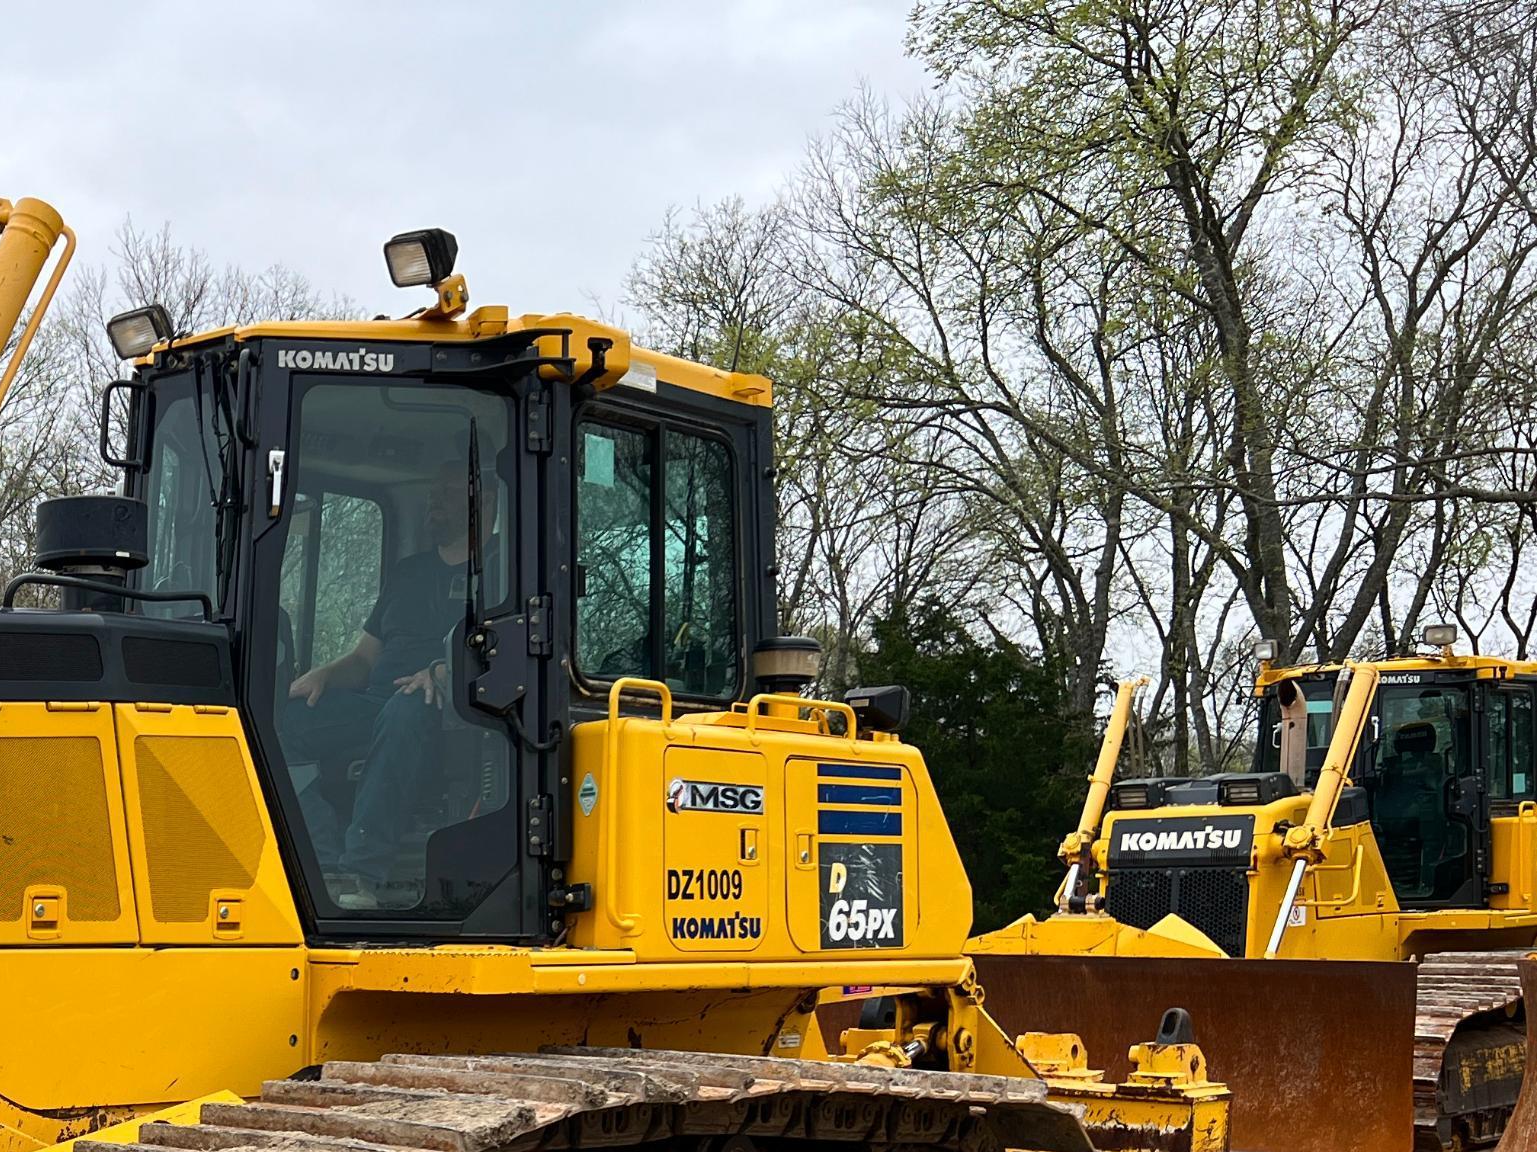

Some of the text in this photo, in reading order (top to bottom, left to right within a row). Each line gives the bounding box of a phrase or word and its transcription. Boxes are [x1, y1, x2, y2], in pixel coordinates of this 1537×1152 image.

[278, 348, 394, 372] KOMATSU
[690, 784, 762, 810] MSG
[1120, 825, 1242, 852] KOMATSU
[667, 869, 743, 900] DZ1009
[829, 862, 847, 893] D
[672, 911, 761, 939] KOMATSU
[828, 899, 898, 941] 65PX
